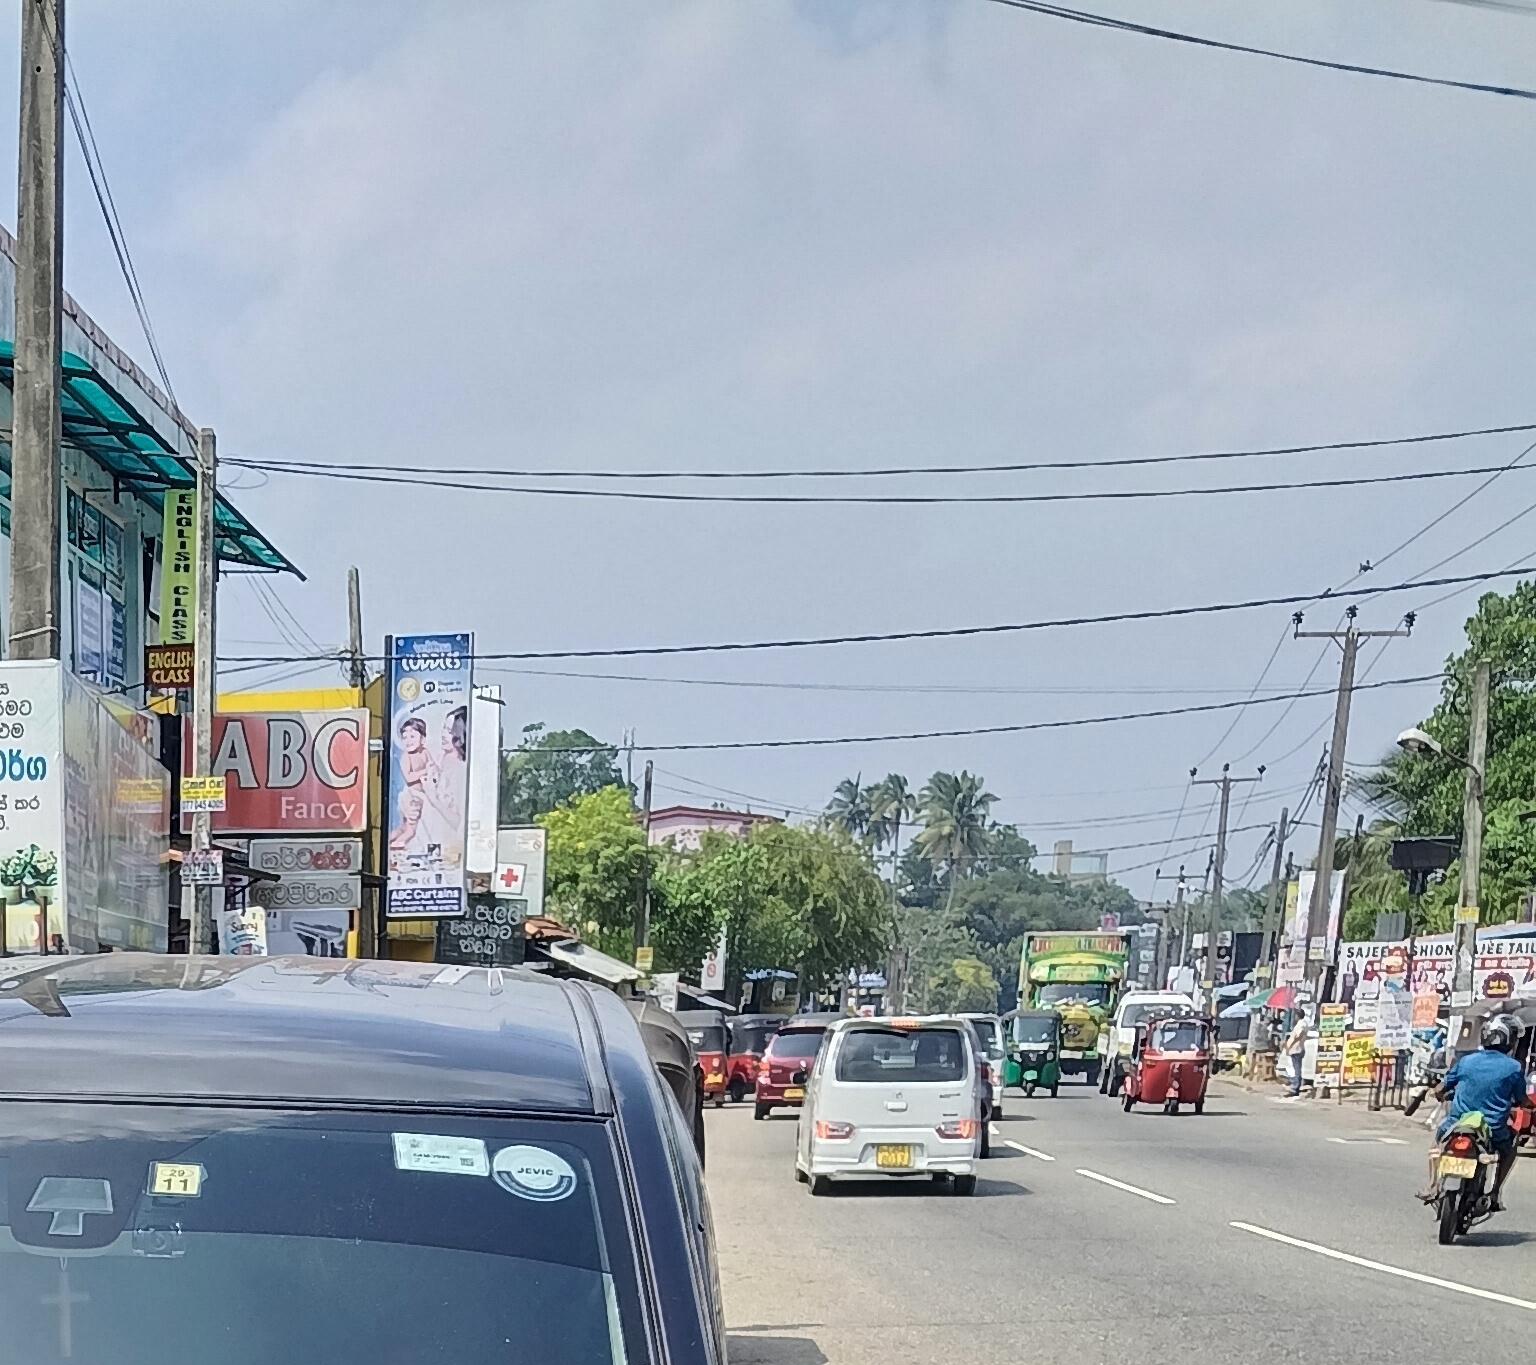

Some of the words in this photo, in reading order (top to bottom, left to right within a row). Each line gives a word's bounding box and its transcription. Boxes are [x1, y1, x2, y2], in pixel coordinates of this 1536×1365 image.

[173, 493, 193, 573] ENGLISH
[170, 585, 190, 641] CLASS
[148, 650, 194, 669] ENGLISH
[151, 669, 190, 684] CLASS
[211, 717, 360, 789] ABC
[281, 796, 357, 823] Fancy
[1346, 945, 1390, 959] SAJEE
[1391, 944, 1455, 958] SHION
[517, 1167, 554, 1176] JEVIC
[163, 1178, 189, 1192] 11
